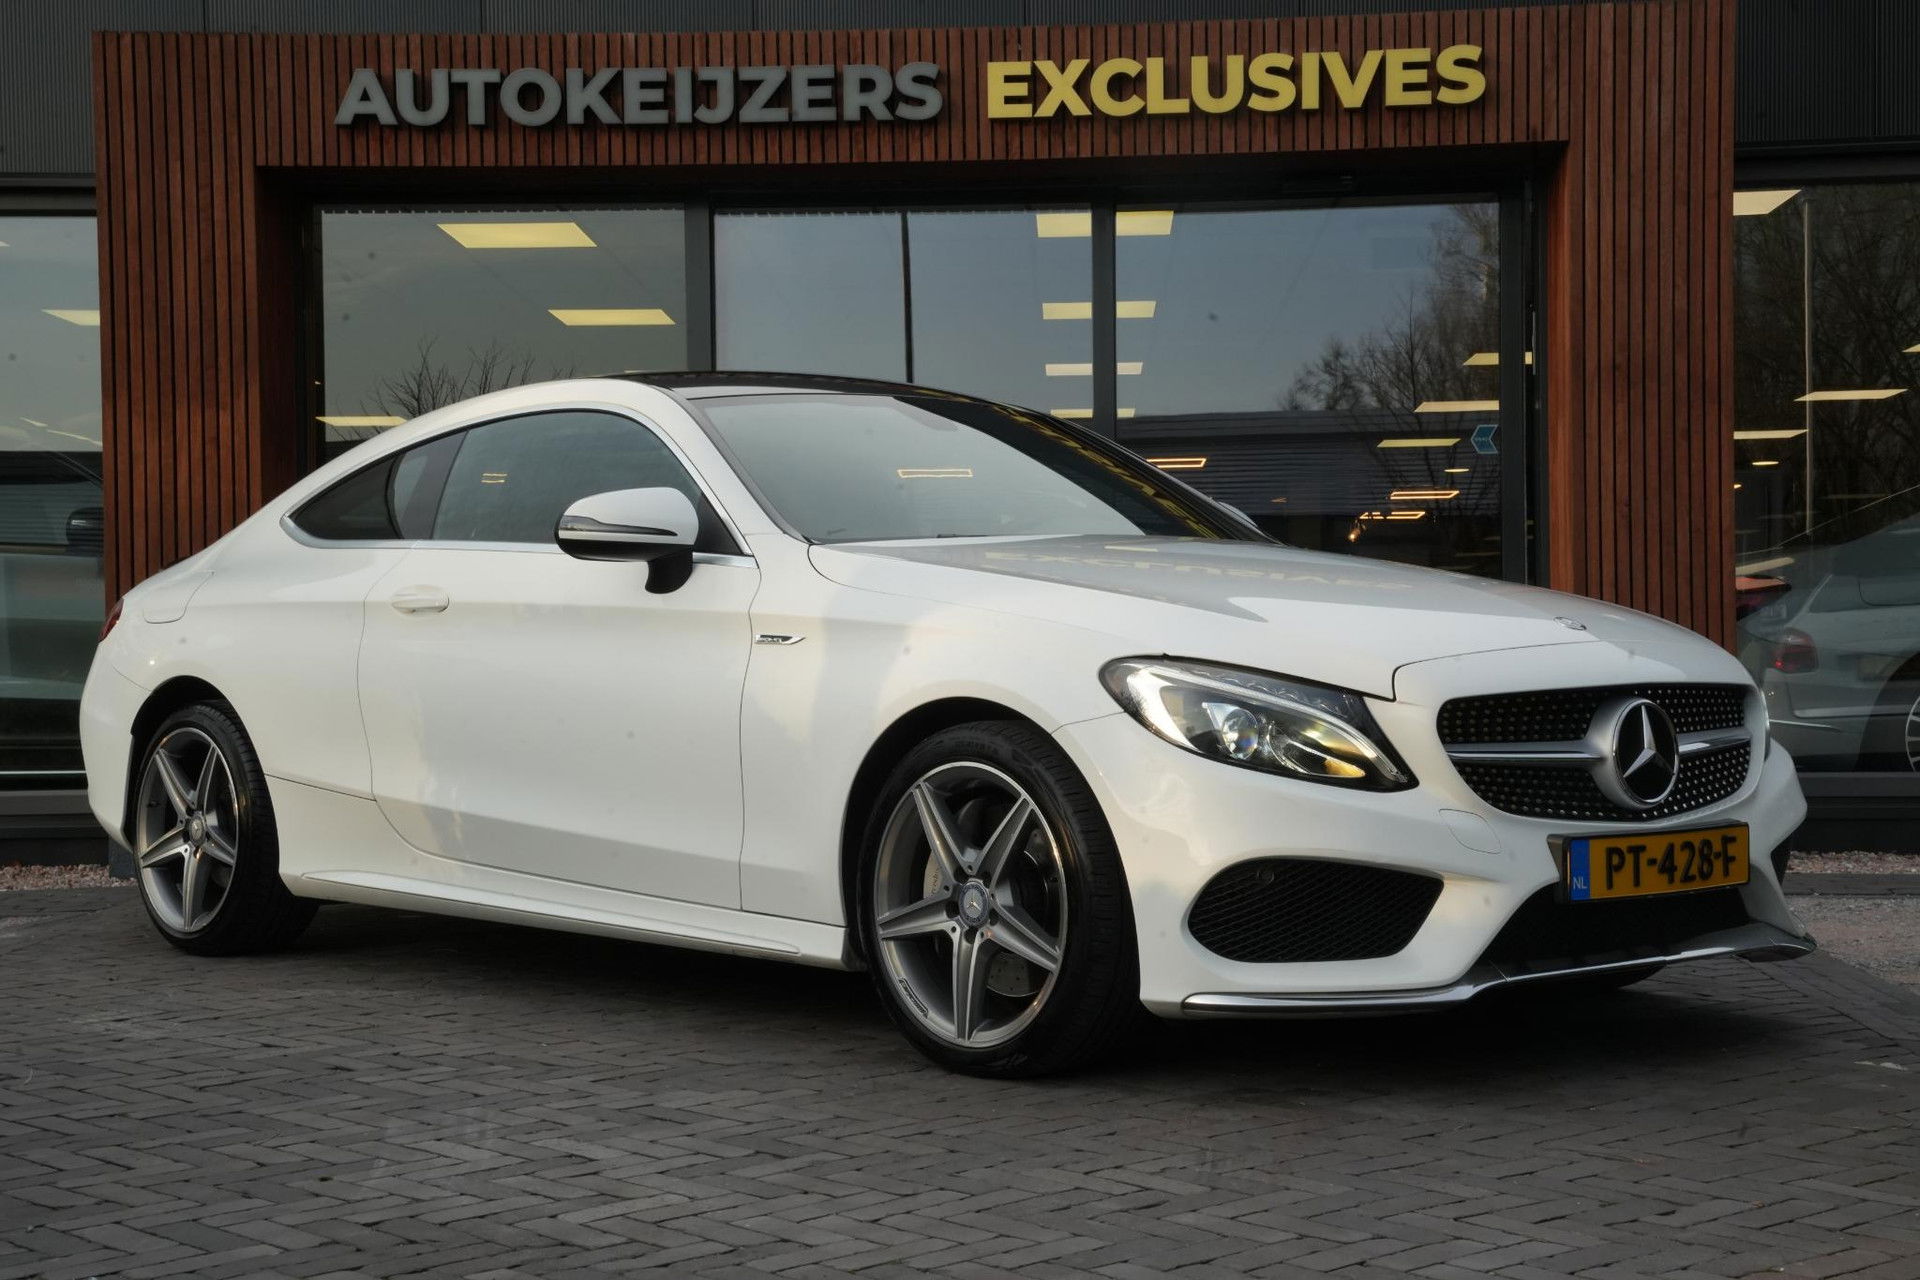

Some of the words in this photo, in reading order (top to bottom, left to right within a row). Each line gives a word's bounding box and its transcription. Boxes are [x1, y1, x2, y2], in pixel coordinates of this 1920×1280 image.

[334, 61, 944, 126] AUTOKEIJZERS
[987, 44, 1487, 119] EXCLUSIVES
[1572, 876, 1588, 889] NL
[1605, 834, 1738, 891] PT-428-F
